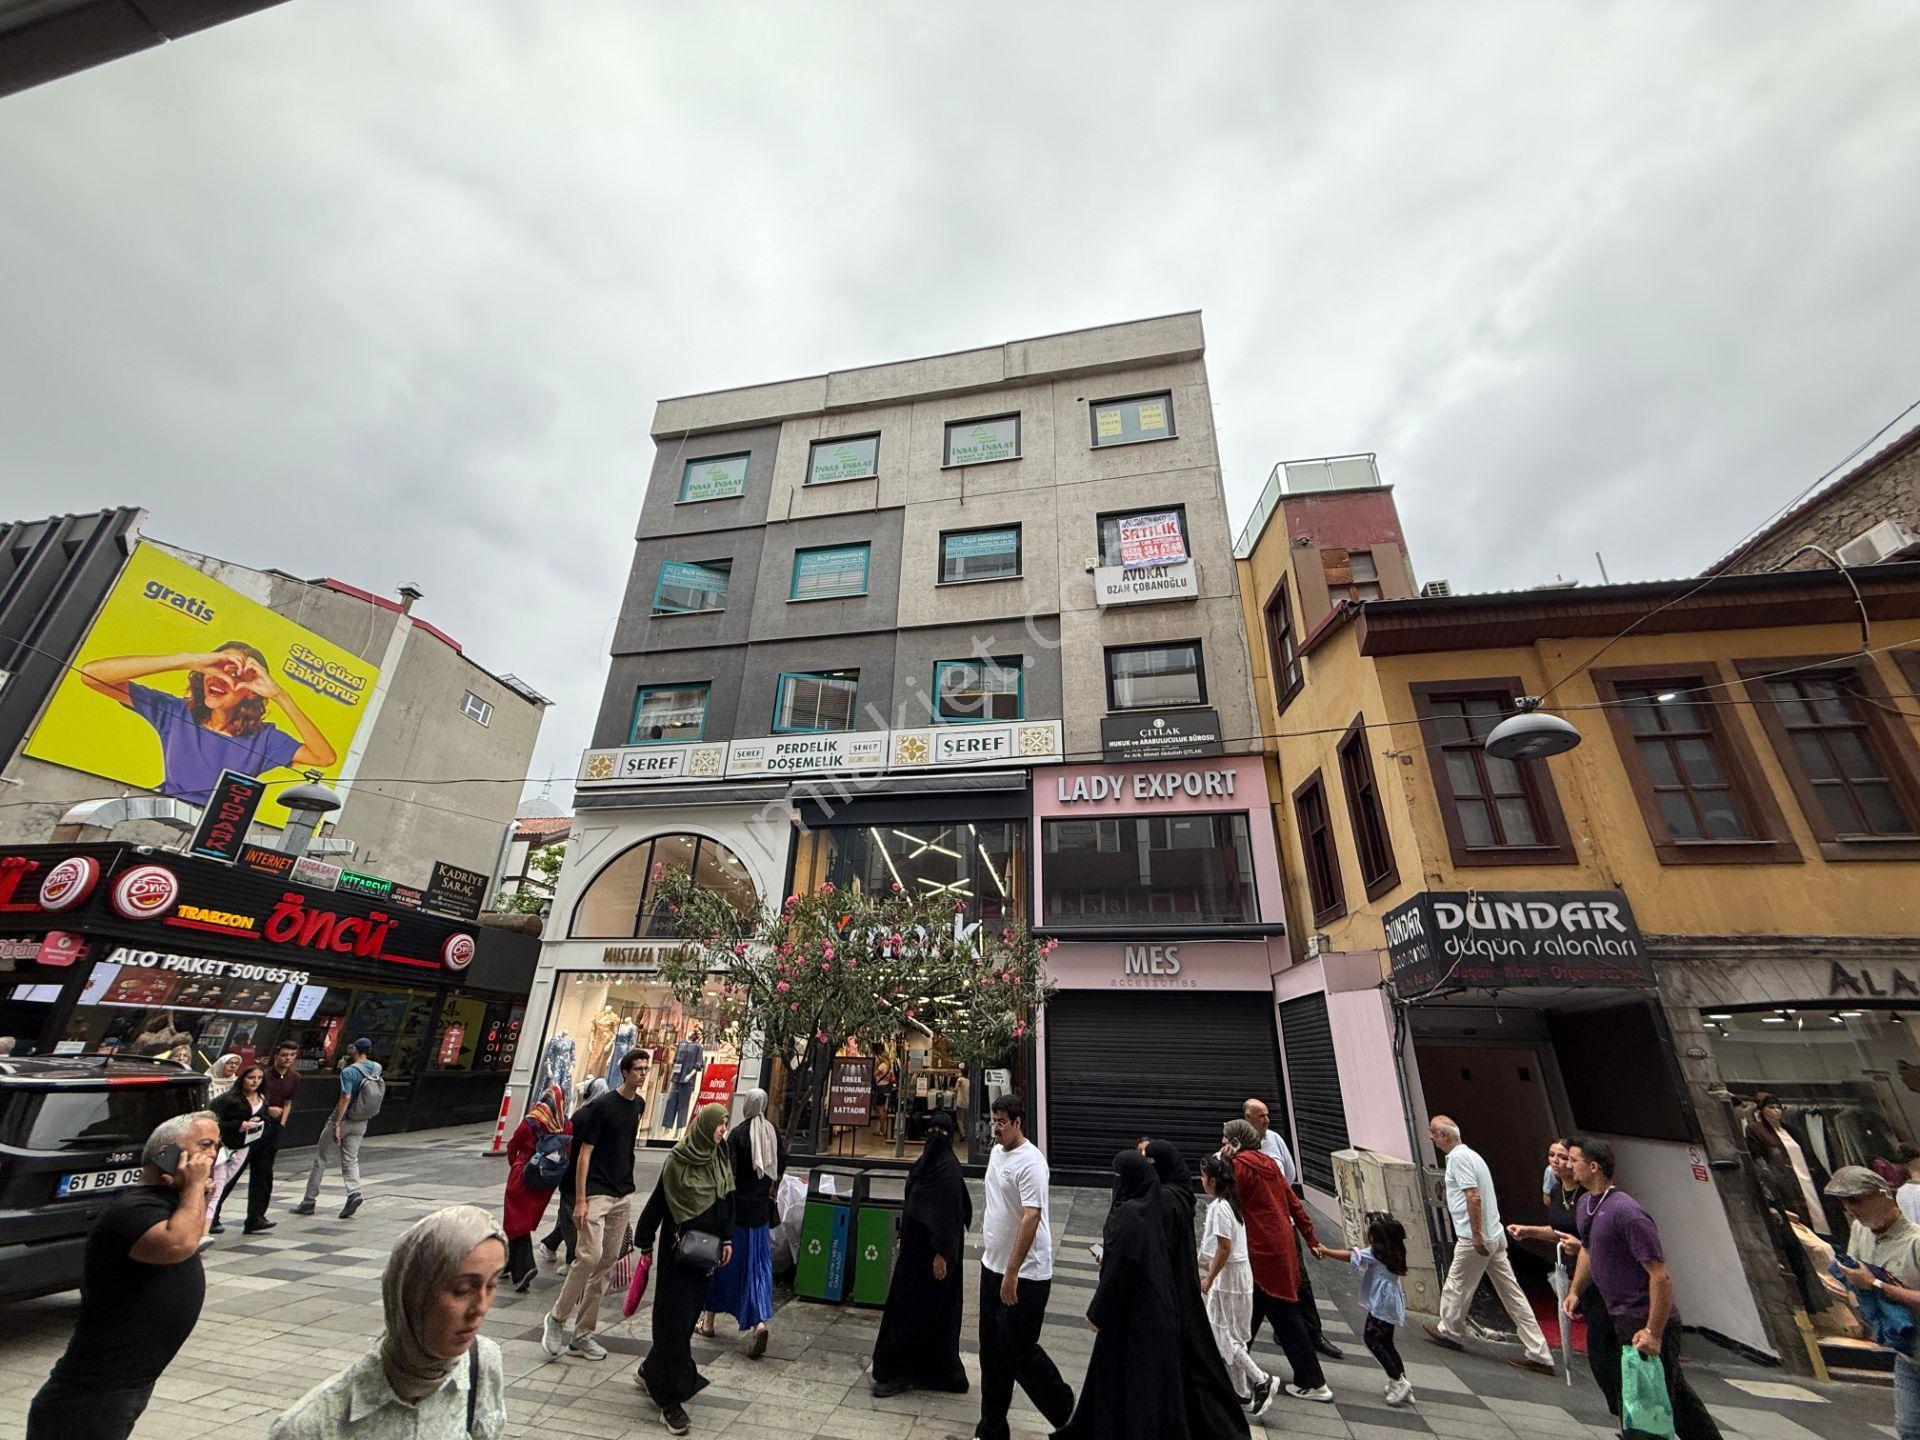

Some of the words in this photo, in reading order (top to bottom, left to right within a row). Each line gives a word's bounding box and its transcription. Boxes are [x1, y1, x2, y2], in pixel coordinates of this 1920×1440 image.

[1121, 521, 1177, 541] SATILIK
[1132, 577, 1188, 595] ÇOBANOĞLU
[143, 580, 215, 623] gratis
[290, 643, 323, 667] Size
[324, 661, 367, 690] Güzel
[283, 658, 361, 706] Bakıyoruz
[1108, 739, 1131, 748] HUKUK
[1140, 736, 1188, 746] ARABULUCULUK
[1188, 734, 1216, 742] BÜROSU
[1139, 727, 1180, 738] ÇITLAK
[776, 738, 838, 755] PERDELİK
[943, 737, 1004, 757] ŞEREF
[627, 756, 679, 775] ŞEREF
[767, 752, 843, 771] DÖŞEMELİK
[1058, 775, 1125, 802] LADY
[1133, 769, 1237, 799] EXPORT
[205, 784, 253, 851] OTOPARK
[438, 864, 483, 888] KADRİYE
[441, 878, 474, 897] SARAÇ
[178, 905, 254, 929] TRABZON
[1433, 897, 1627, 932] DÜNDAR
[1385, 907, 1424, 949] DÜNDAR
[603, 947, 653, 963] MUSTAFA
[1533, 934, 1638, 956] salonları
[160, 954, 225, 977] PAKET
[228, 963, 263, 981] 500
[1125, 946, 1181, 976] MES
[1110, 978, 1198, 988] accessories
[709, 1078, 726, 1088] BÜYÜK
[842, 1075, 862, 1083] ERKEK
[699, 1091, 715, 1099] SEZON
[715, 1092, 730, 1101] SONU
[831, 1085, 871, 1094] REYONUMUZ
[833, 1106, 866, 1114] KATTADIR
[69, 1174, 88, 1191] 61
[94, 1171, 116, 1188] BB
